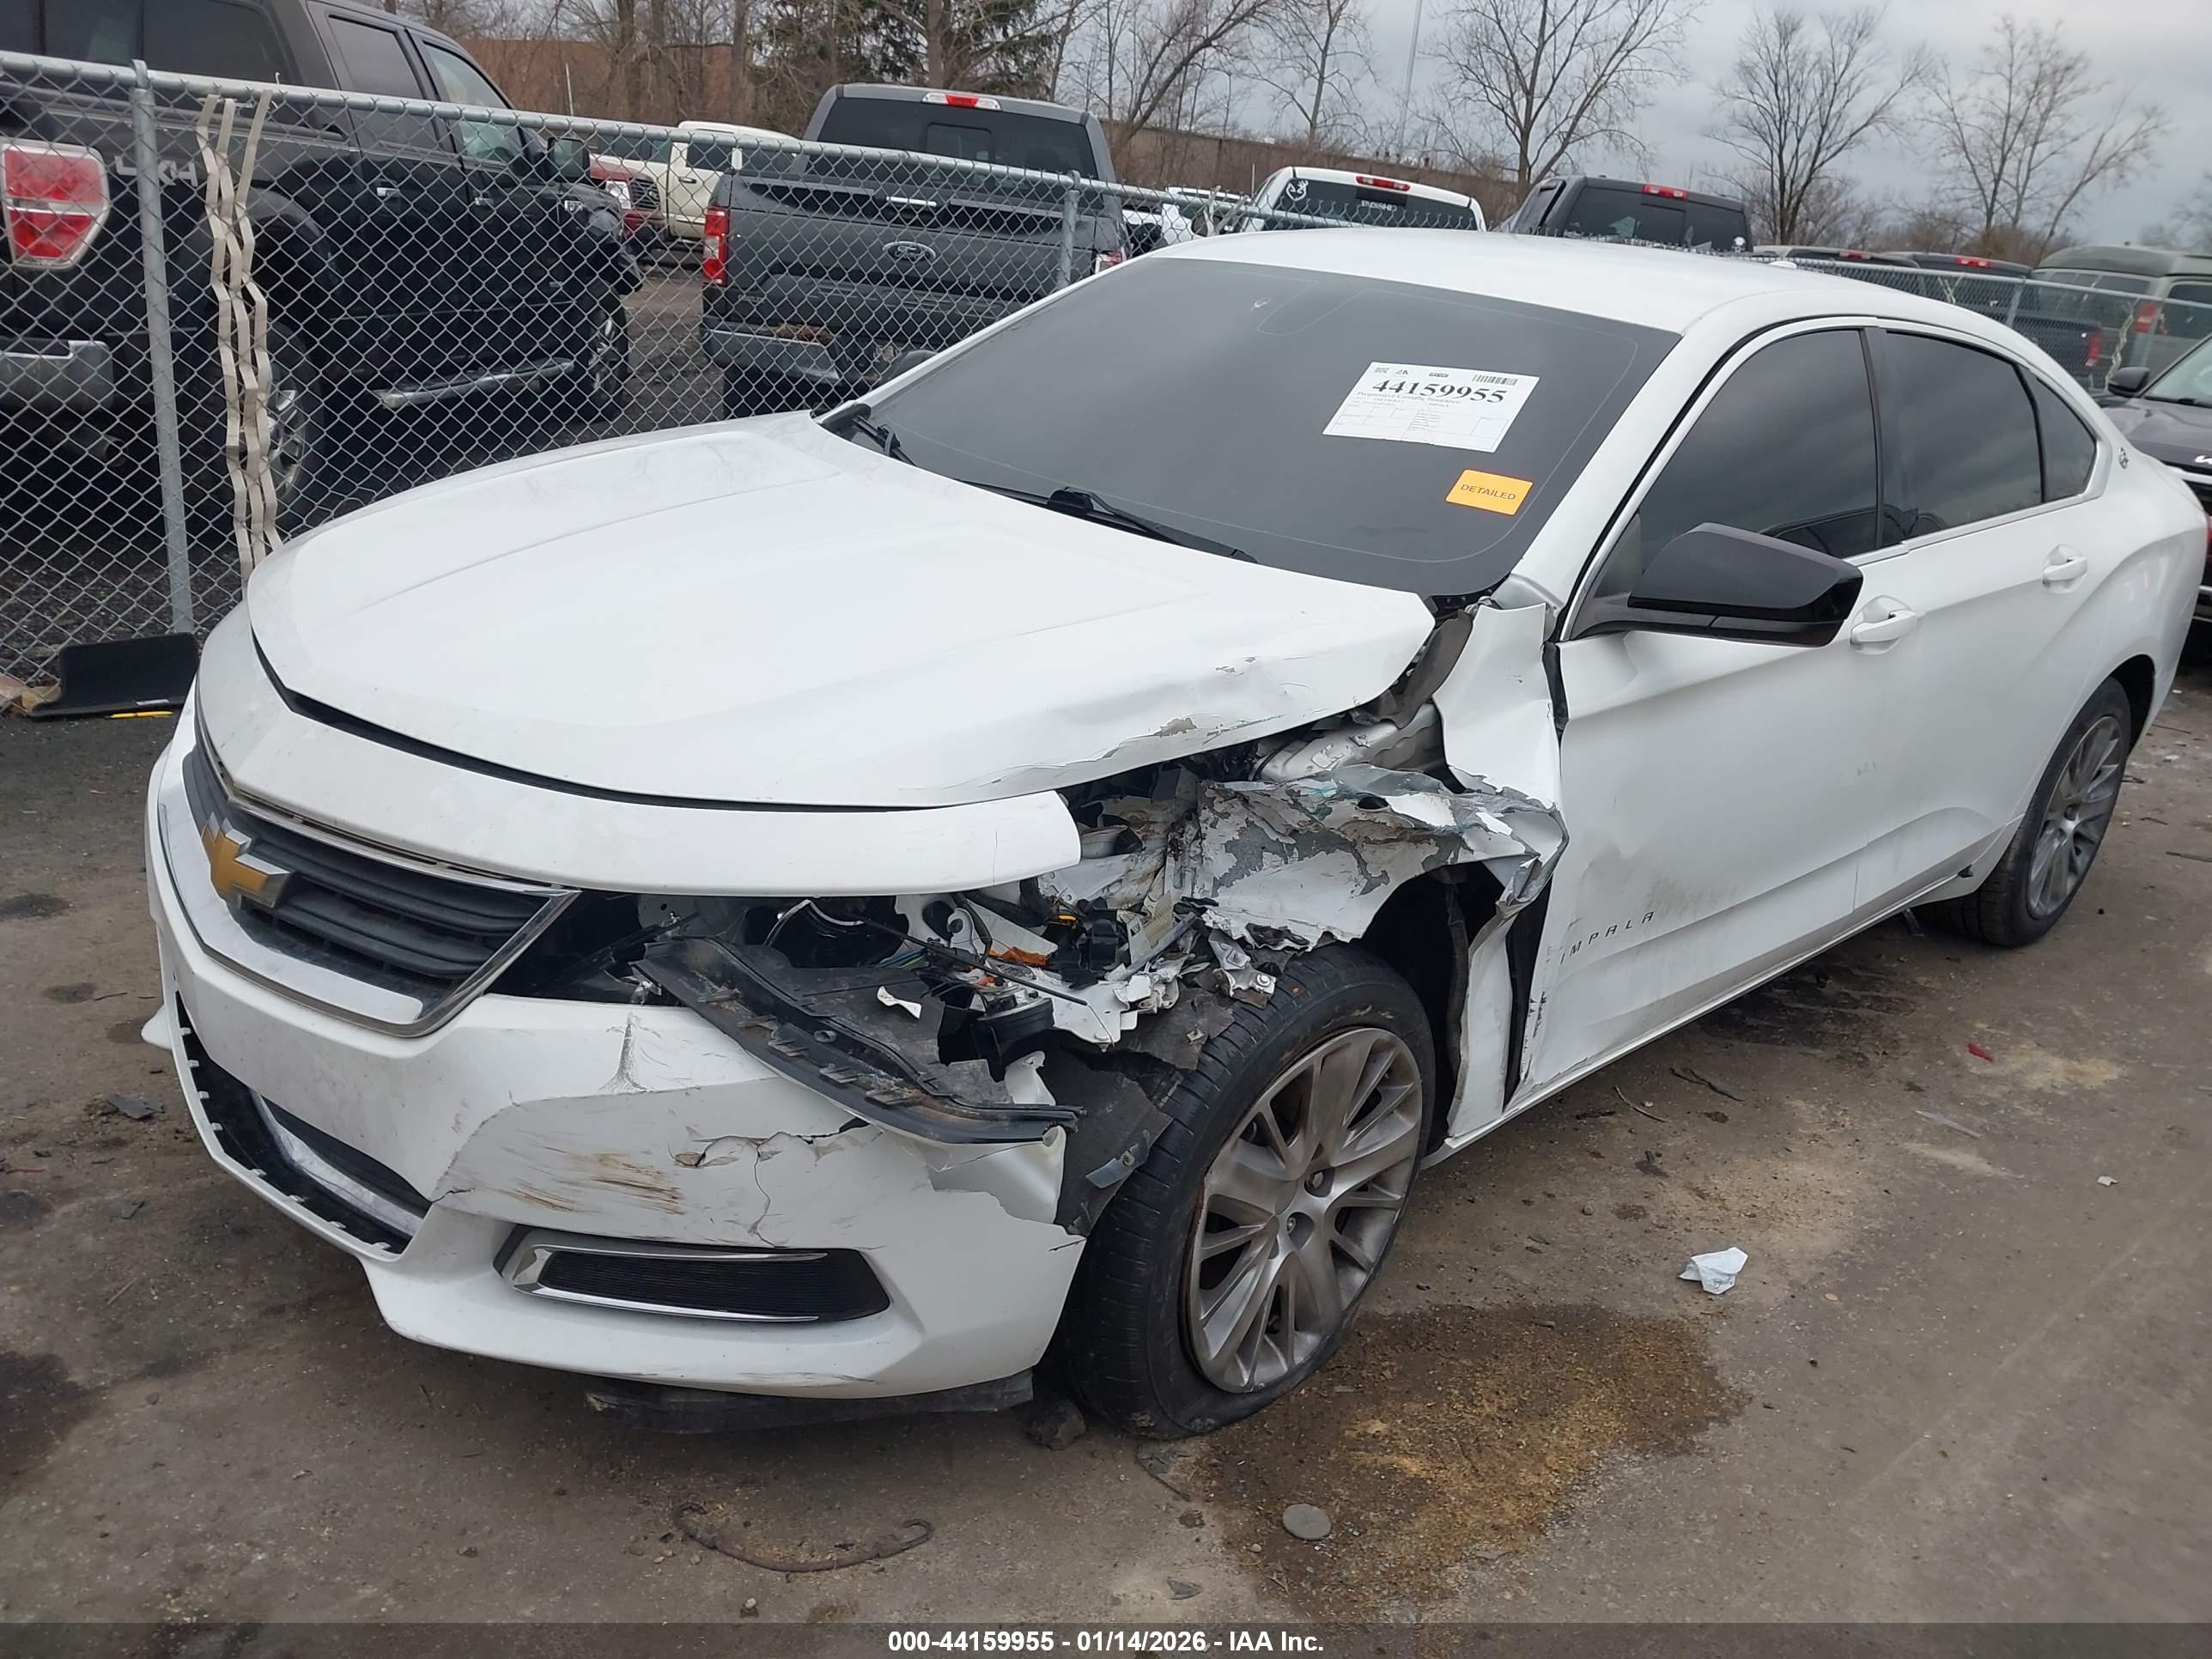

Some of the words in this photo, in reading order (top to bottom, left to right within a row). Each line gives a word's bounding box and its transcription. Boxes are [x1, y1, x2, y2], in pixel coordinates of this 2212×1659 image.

[1371, 380, 1508, 404] 44159955
[1460, 483, 1516, 500] DETAILED
[1559, 911, 1654, 964] IMPALA
